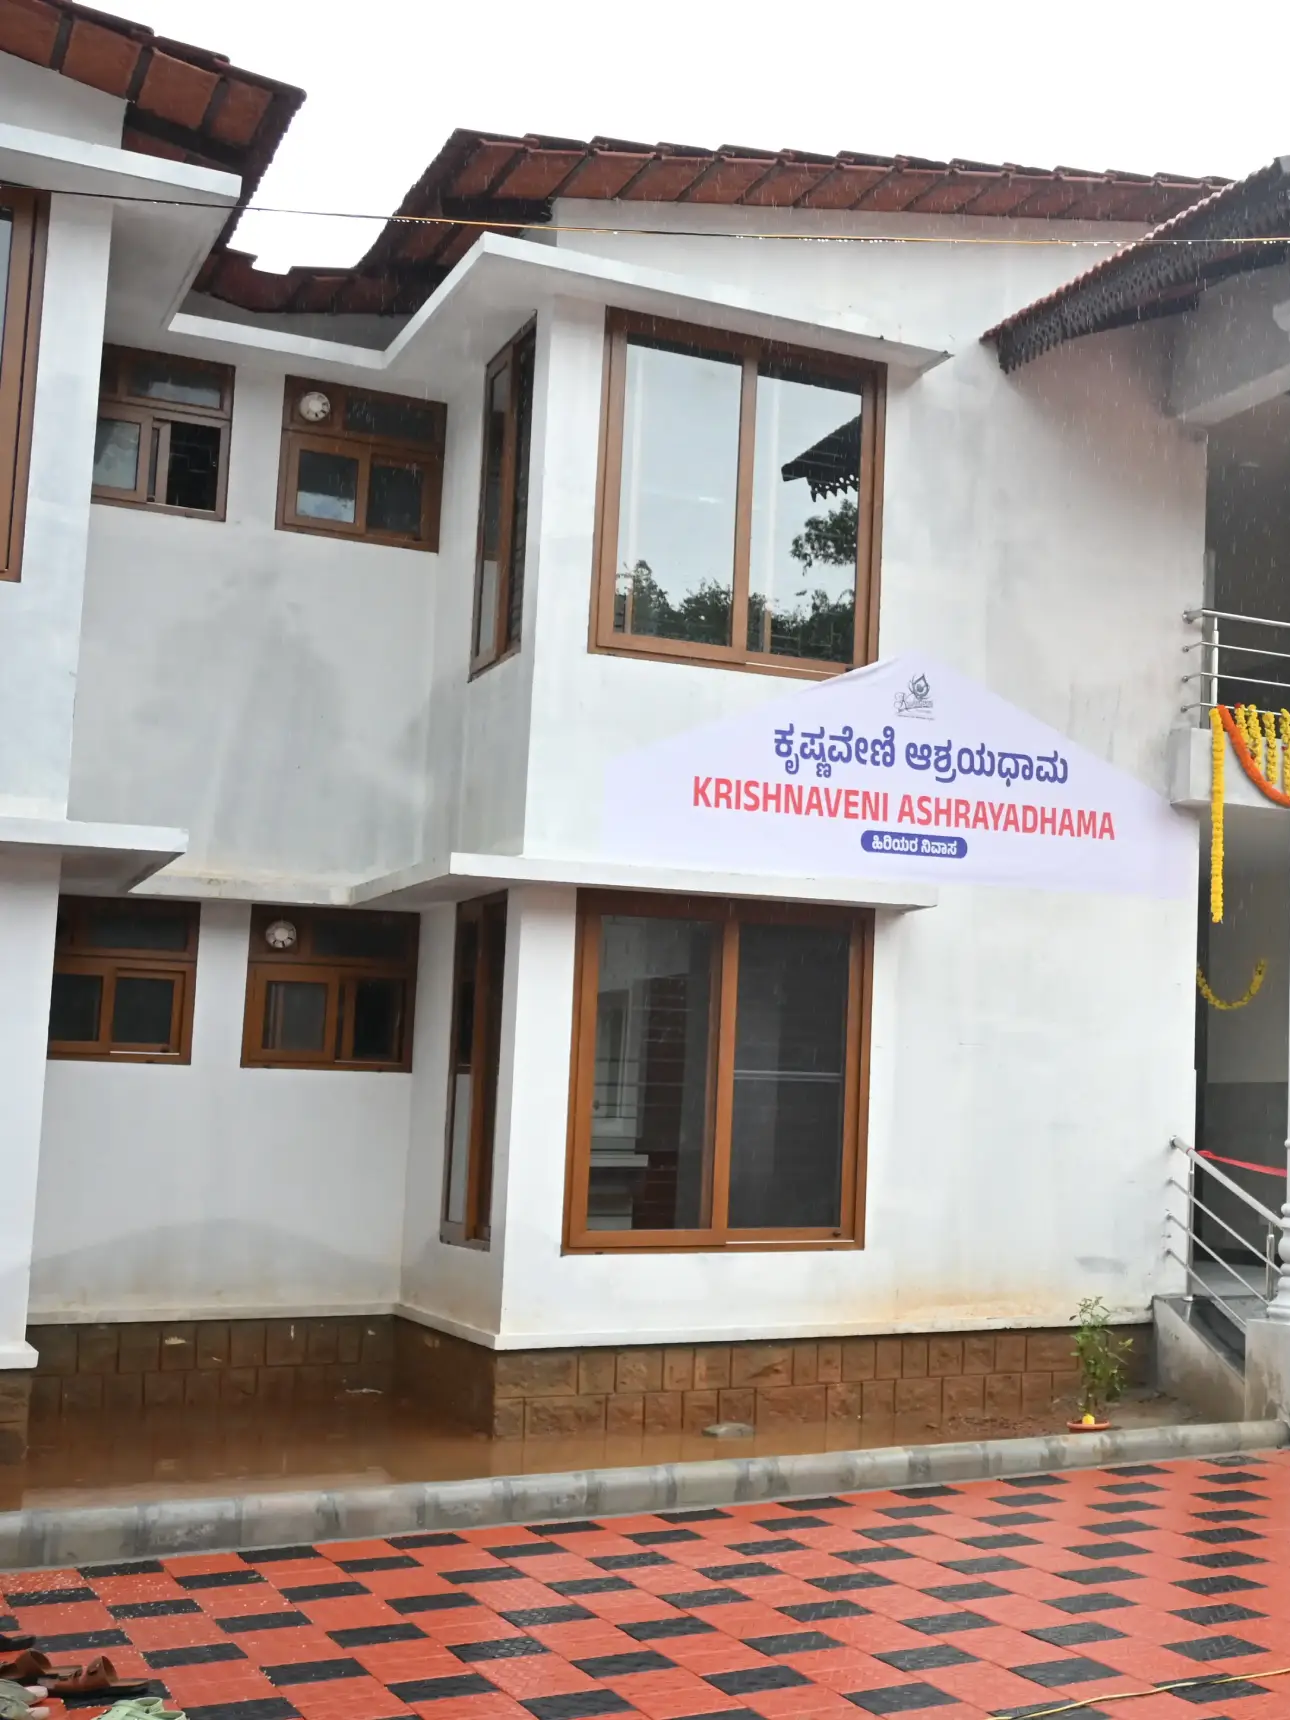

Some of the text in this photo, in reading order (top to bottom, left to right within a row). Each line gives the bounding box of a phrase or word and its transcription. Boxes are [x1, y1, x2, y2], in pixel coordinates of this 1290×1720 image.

[774, 723, 1068, 787] ಕೃಷ್ಣವೇಣಿ ಆಶ್ರಯಧಾಮ
[692, 776, 1115, 841] KRISHNAVENI ASHRAYADHAMA
[872, 834, 957, 856] ಹಿರಿಯರ ನಿವಾಸ
